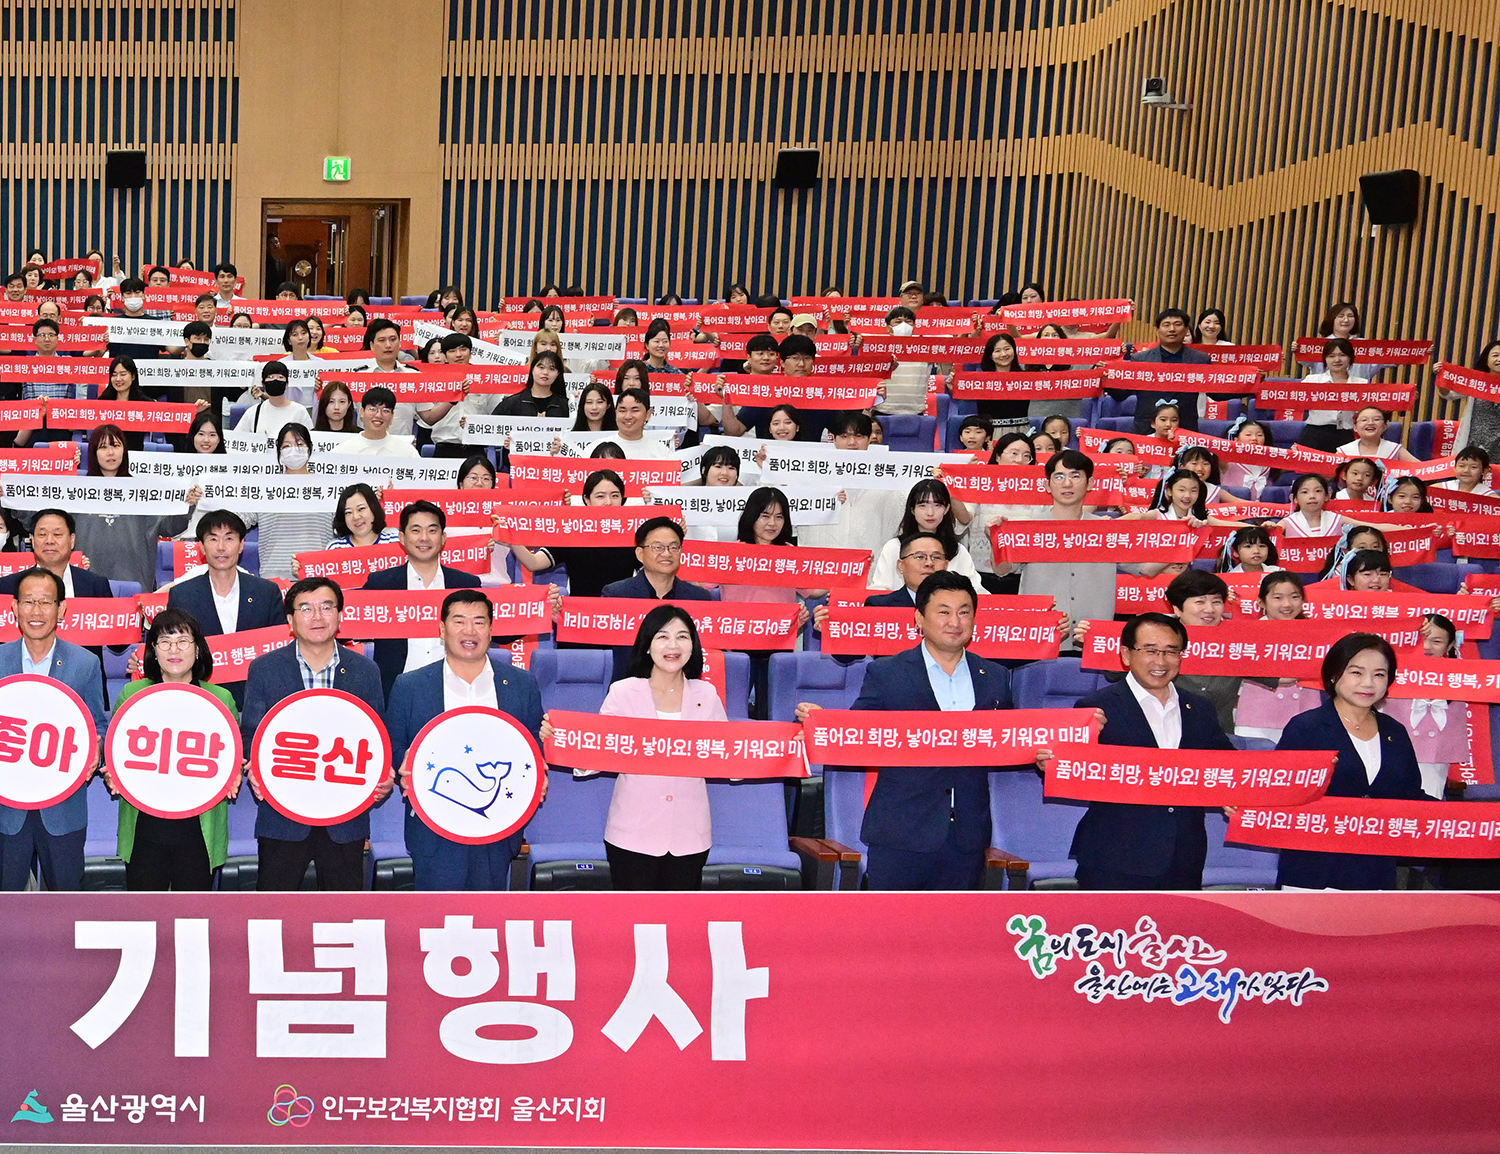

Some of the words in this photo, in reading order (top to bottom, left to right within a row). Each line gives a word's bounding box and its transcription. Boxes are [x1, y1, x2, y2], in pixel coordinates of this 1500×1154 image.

[1107, 368, 1135, 380] 품어요!
[1135, 370, 1156, 383] 희망,
[1157, 371, 1186, 383] 낳아요!
[1186, 372, 1207, 384] 행복,
[1207, 373, 1237, 384] 키워요!
[1237, 373, 1257, 384] 미래
[1260, 389, 1289, 401] 품어요!
[1289, 390, 1309, 402] 희망,
[1310, 391, 1339, 402] 낳아요!
[1340, 391, 1360, 403] 행복,
[1361, 391, 1391, 403] 키워요!
[1391, 391, 1411, 402] 미래
[23, 408, 40, 420] 미래
[51, 407, 78, 420] 품어요!
[79, 408, 98, 421] 희망,
[98, 409, 126, 421] 낳아요!
[127, 410, 146, 423] 행복,
[146, 411, 174, 423] 키워요!
[174, 412, 192, 424] 미래
[768, 458, 805, 472] 품어요!
[807, 460, 832, 475] 희망,
[834, 461, 872, 476] 낳아요!
[874, 463, 899, 478] 행복,
[901, 464, 935, 481] 키워요
[5, 484, 39, 498] 품어요!
[41, 485, 65, 500] 희망,
[66, 487, 101, 501] 낳아요!
[103, 488, 126, 502] 행복,
[128, 488, 163, 502] 키워요!
[164, 489, 186, 502] 미래
[553, 727, 601, 751] 품어요!
[604, 733, 638, 756] 희망,
[642, 736, 692, 758] 낳아요!
[695, 738, 730, 760] 행복,
[733, 739, 785, 760] 키워요!
[813, 726, 864, 747] 품어요!
[867, 727, 903, 749] 희망,
[906, 728, 958, 748] 낳아요!
[961, 727, 997, 749] 행복,
[1001, 726, 1054, 748] 키워요!
[1058, 725, 1090, 744] 미래
[124, 726, 225, 778] 희망
[271, 732, 373, 785] 울산
[1055, 759, 1107, 781] 품어요!
[1109, 763, 1144, 786] 희망,
[1148, 765, 1200, 787] 낳아요!
[1203, 767, 1237, 789] 행복,
[1240, 768, 1294, 788] 키워요!
[1294, 768, 1328, 788] 미래
[1240, 809, 1293, 830] 품어요!
[1294, 812, 1329, 835] 희망,
[1333, 815, 1385, 836] 낳아요!
[1387, 817, 1421, 839] 행복,
[1424, 818, 1477, 840] 키워요!
[70, 916, 769, 1064] 기념행사
[61, 1094, 204, 1123] 울산광역시
[323, 1097, 499, 1121] 인구보건복지협회
[511, 1097, 605, 1122] 울산지회
